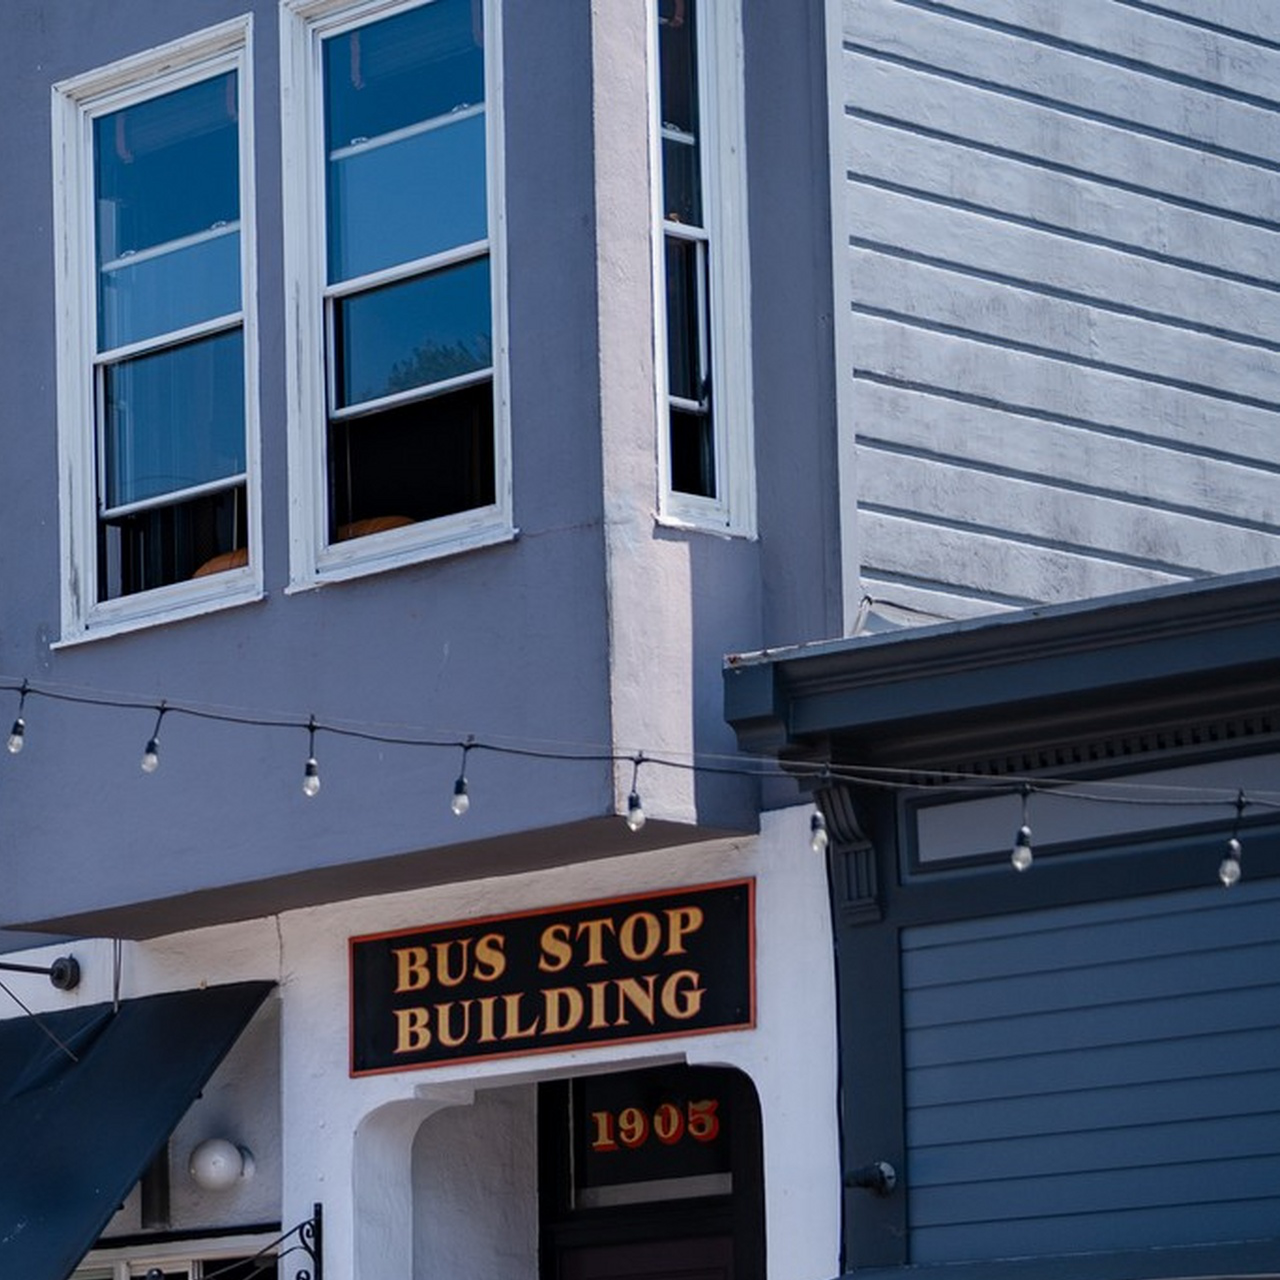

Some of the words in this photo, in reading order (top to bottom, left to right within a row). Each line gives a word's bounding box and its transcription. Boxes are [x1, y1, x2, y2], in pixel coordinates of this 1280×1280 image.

[392, 933, 508, 994] BUS
[537, 906, 704, 973] STOP
[393, 969, 707, 1054] BUILDING
[591, 1098, 720, 1151] 1905
